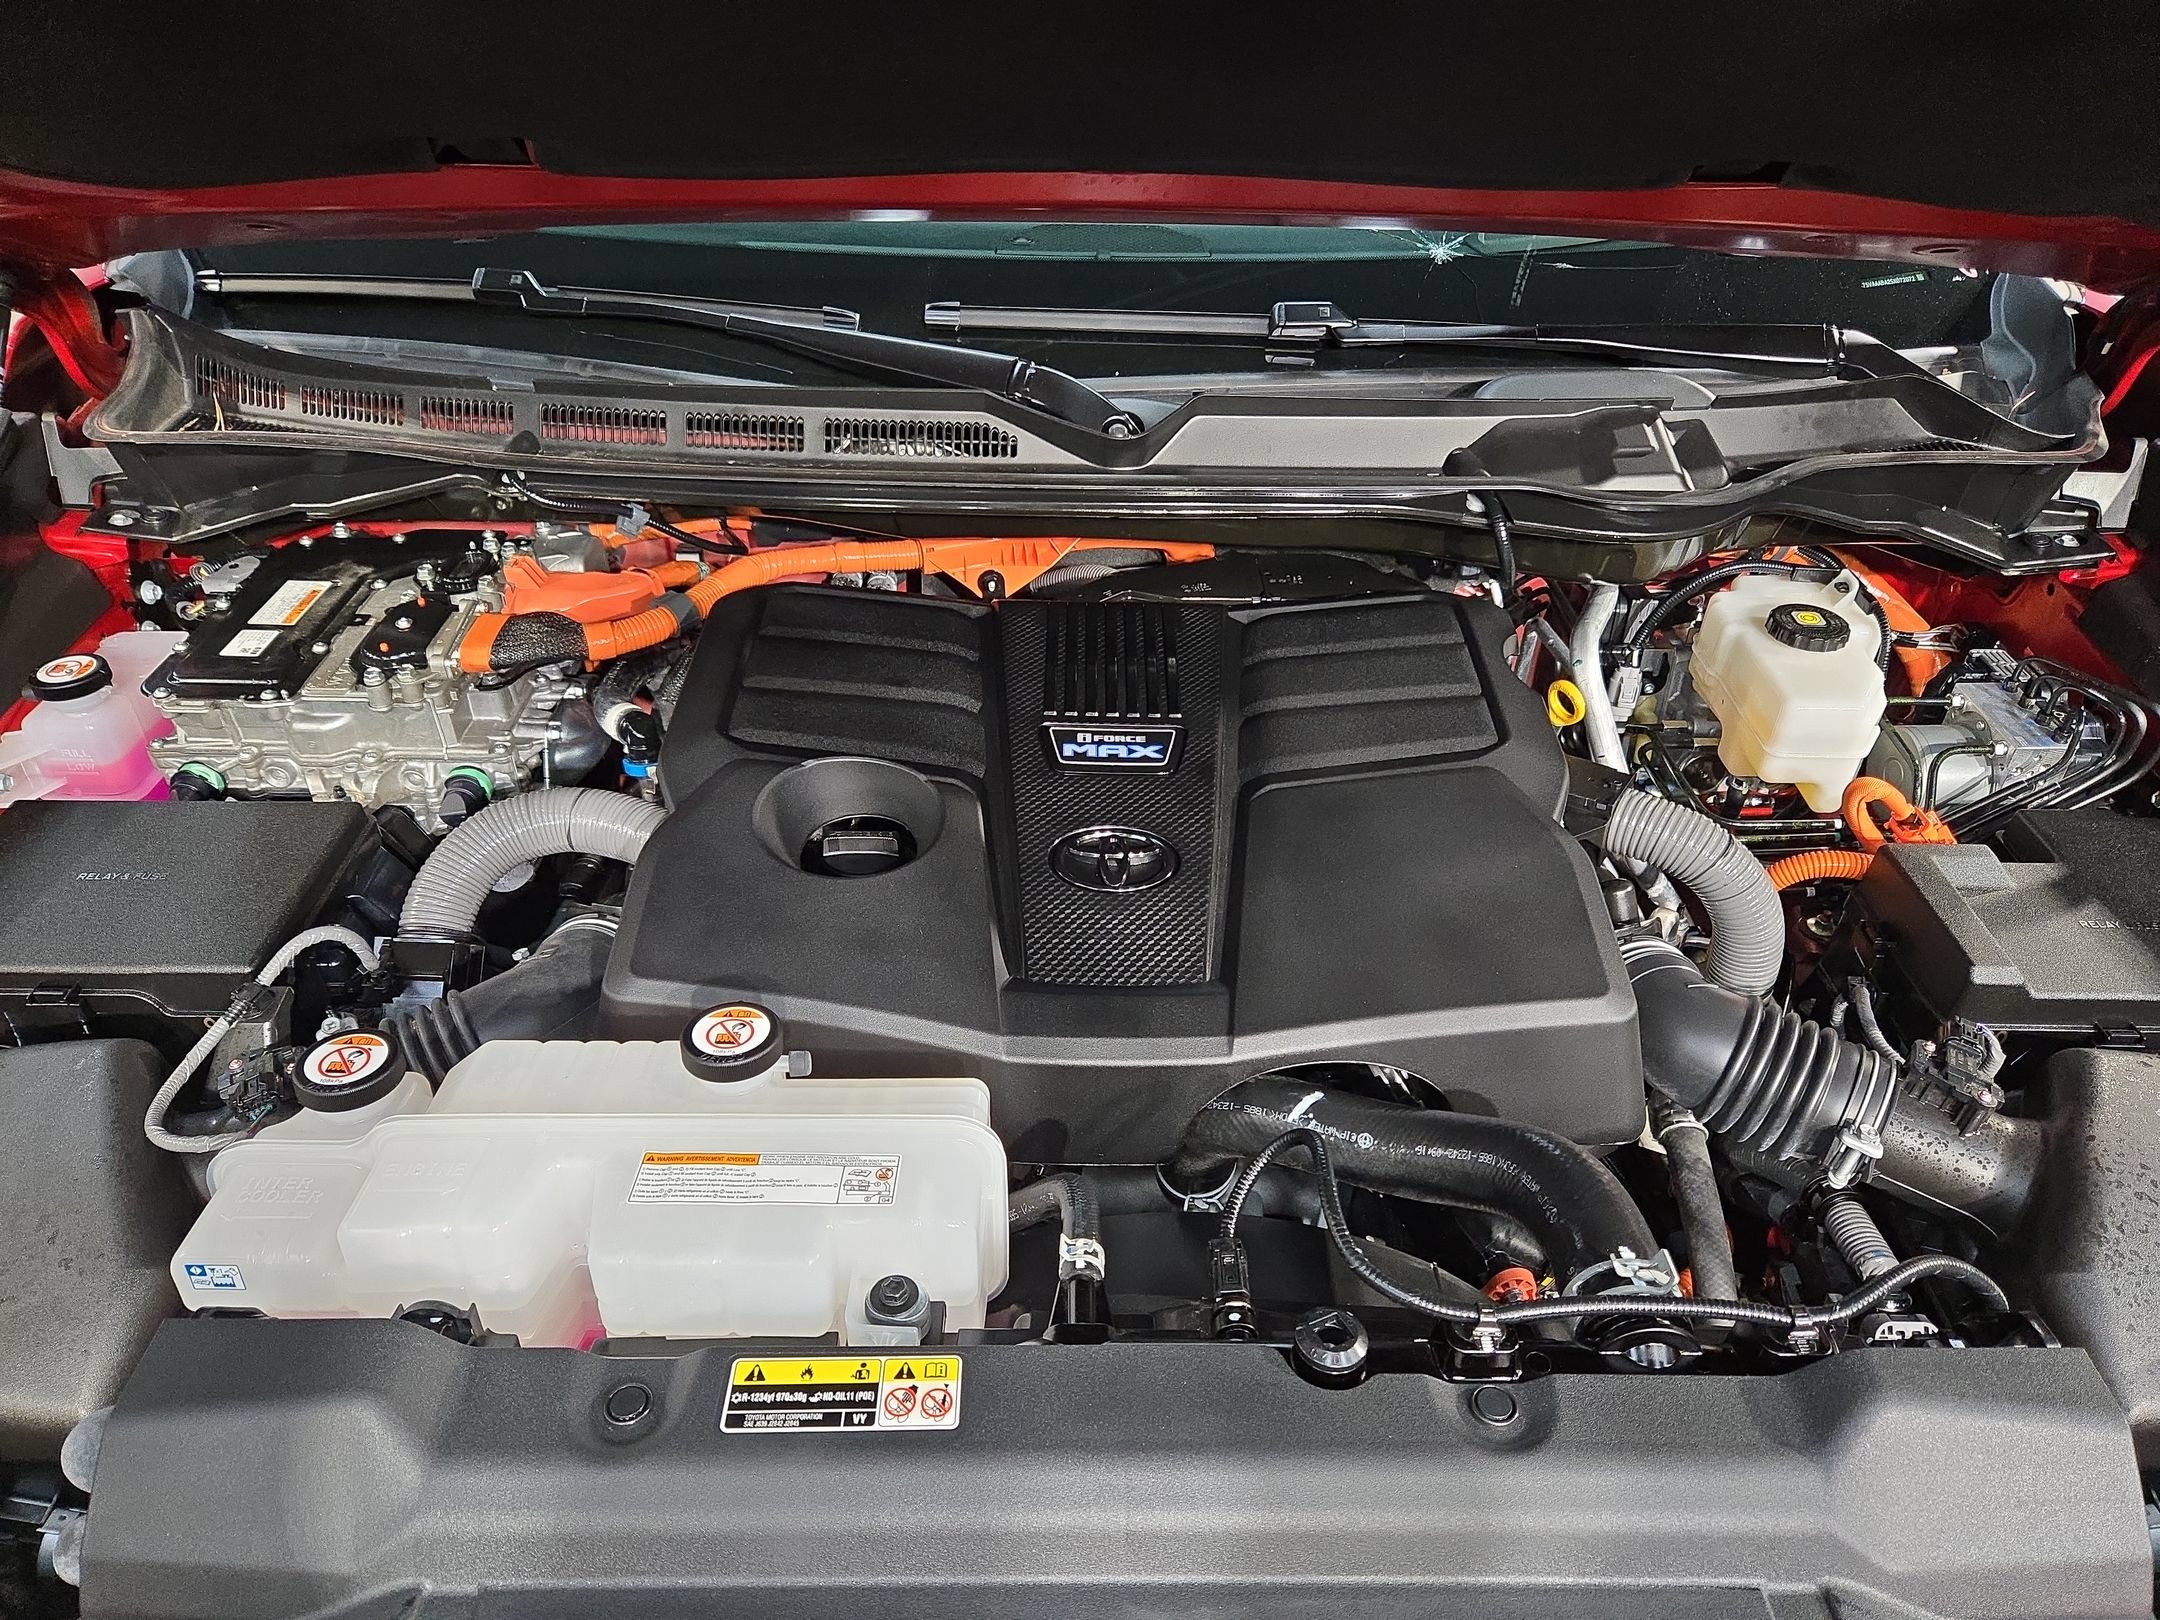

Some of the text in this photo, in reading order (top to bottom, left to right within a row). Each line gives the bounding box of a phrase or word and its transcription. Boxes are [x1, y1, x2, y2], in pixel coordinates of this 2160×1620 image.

[1063, 744, 1164, 758] MAX
[76, 872, 119, 880] RELAY
[133, 872, 168, 880] FUSE
[242, 1176, 315, 1190] INTER
[238, 1190, 324, 1204] COOLER
[855, 1390, 875, 1402] (POE)
[786, 1413, 823, 1421] CORPORATION
[853, 1413, 868, 1424] VY
